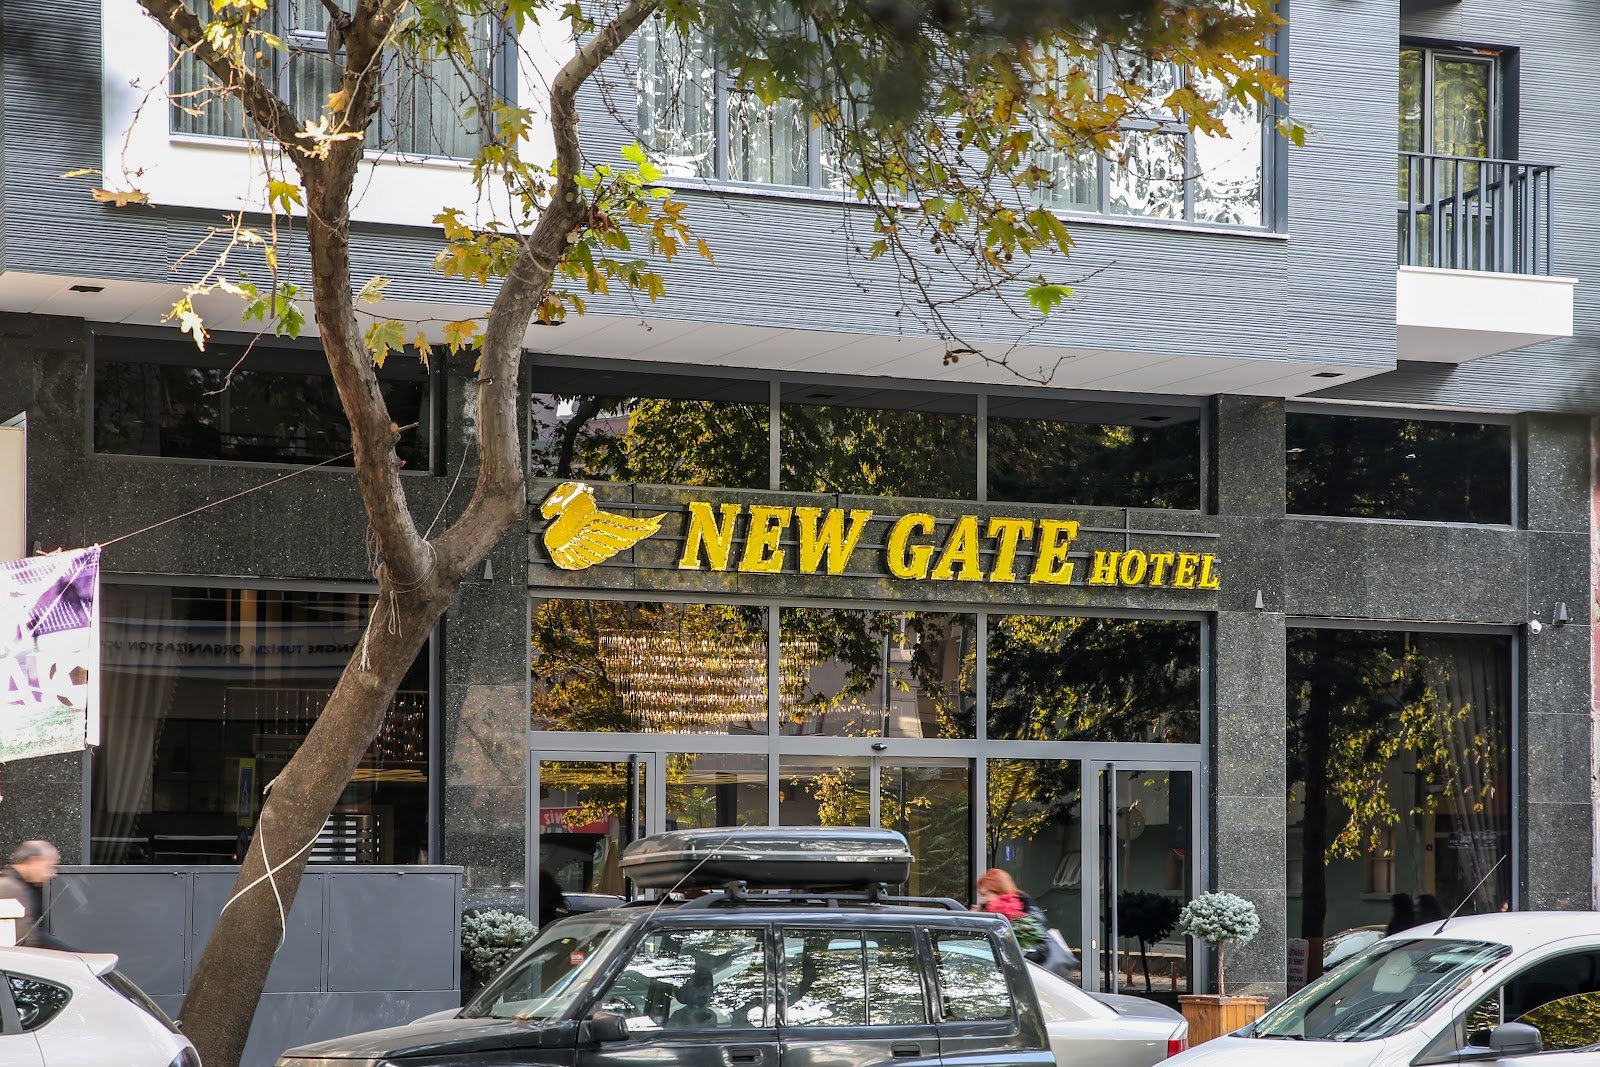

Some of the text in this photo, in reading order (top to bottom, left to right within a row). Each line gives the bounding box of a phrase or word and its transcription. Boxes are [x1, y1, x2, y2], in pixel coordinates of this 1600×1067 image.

[678, 501, 1220, 590] NEW GATE HOTEL
